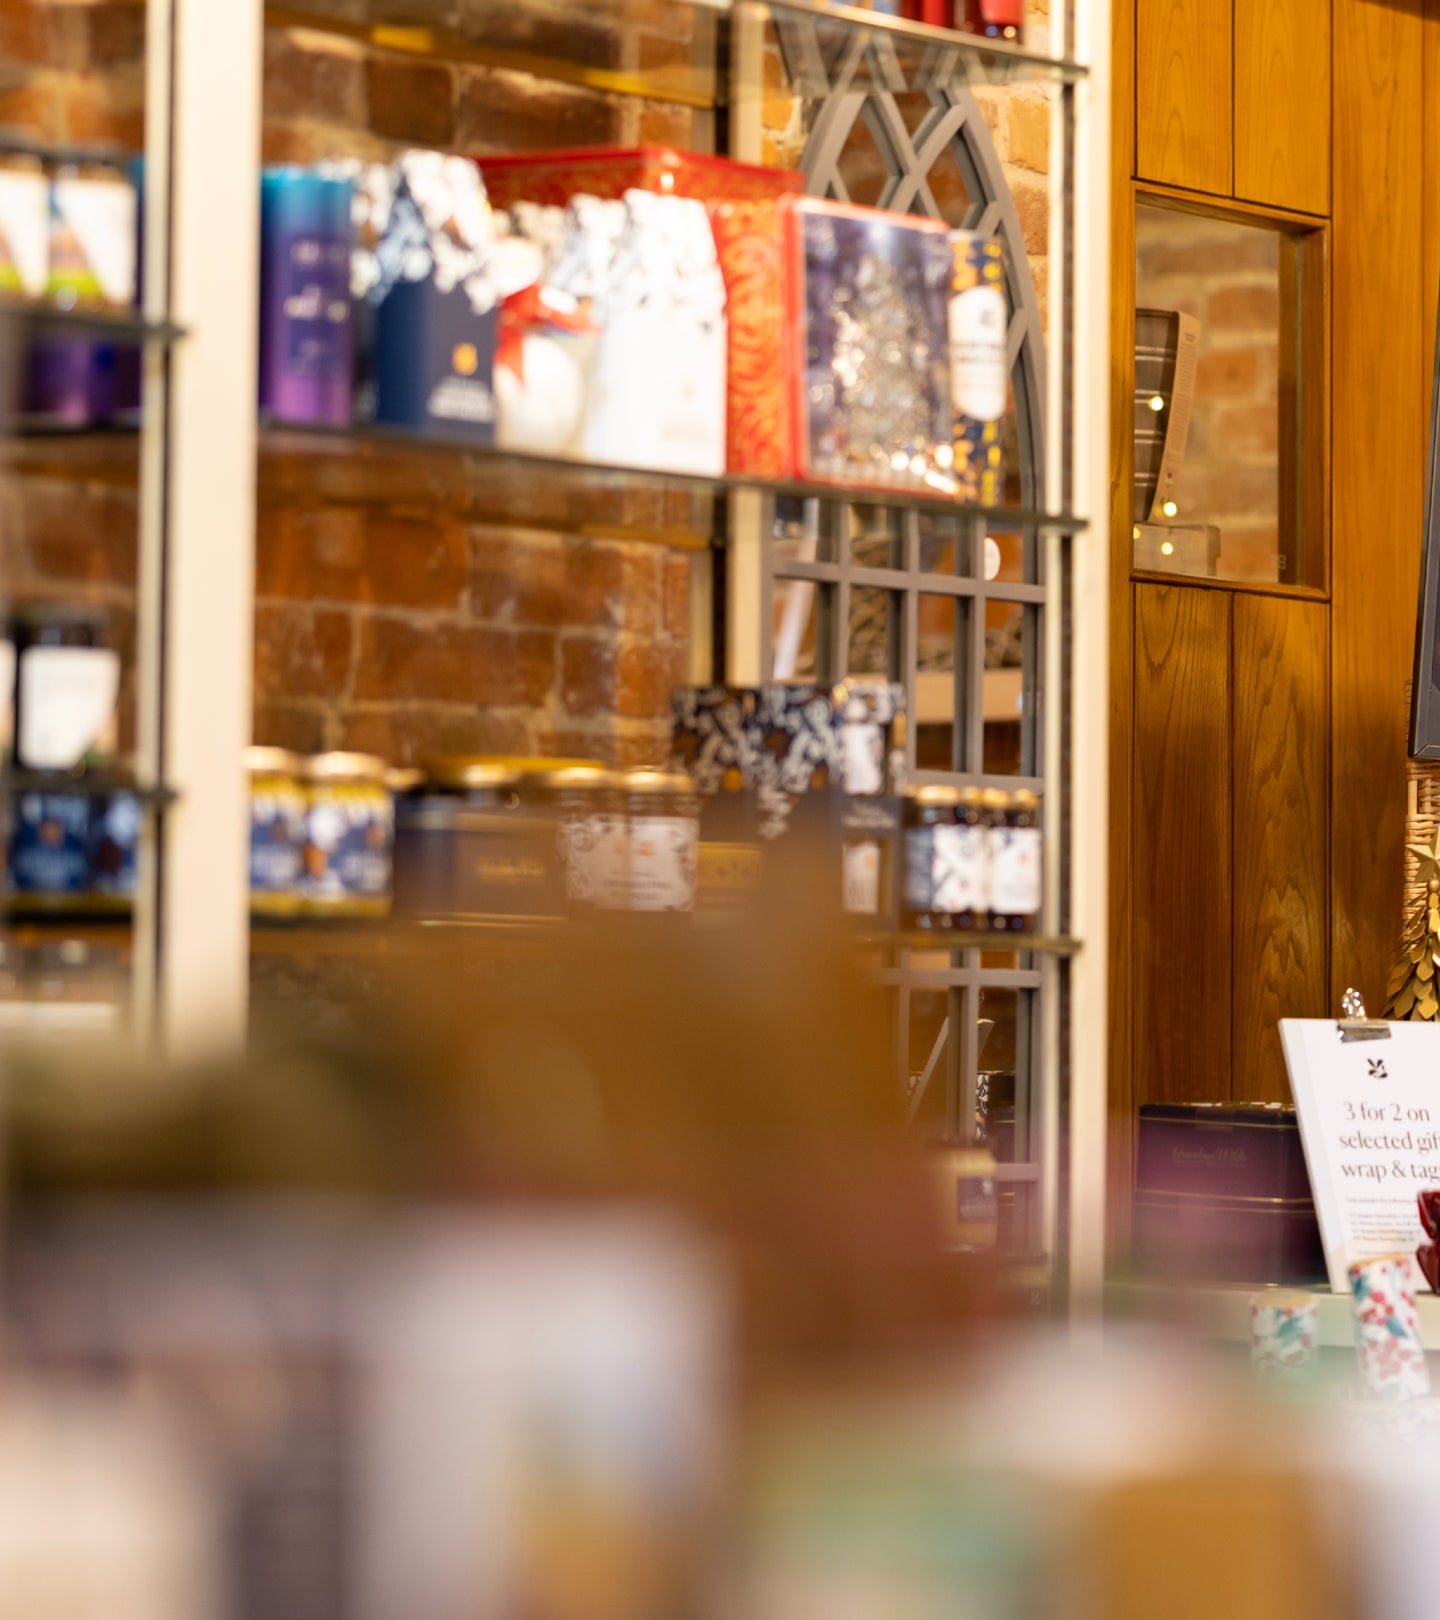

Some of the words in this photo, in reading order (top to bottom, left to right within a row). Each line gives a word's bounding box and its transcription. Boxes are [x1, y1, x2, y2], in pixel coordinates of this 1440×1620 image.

[1344, 1101, 1356, 1120] 3
[1360, 1101, 1386, 1121] for
[1390, 1102, 1403, 1121] 2
[1407, 1108, 1431, 1121] on
[1339, 1130, 1413, 1150] selected
[1340, 1163, 1387, 1183] wrap
[1391, 1159, 1407, 1178] &
